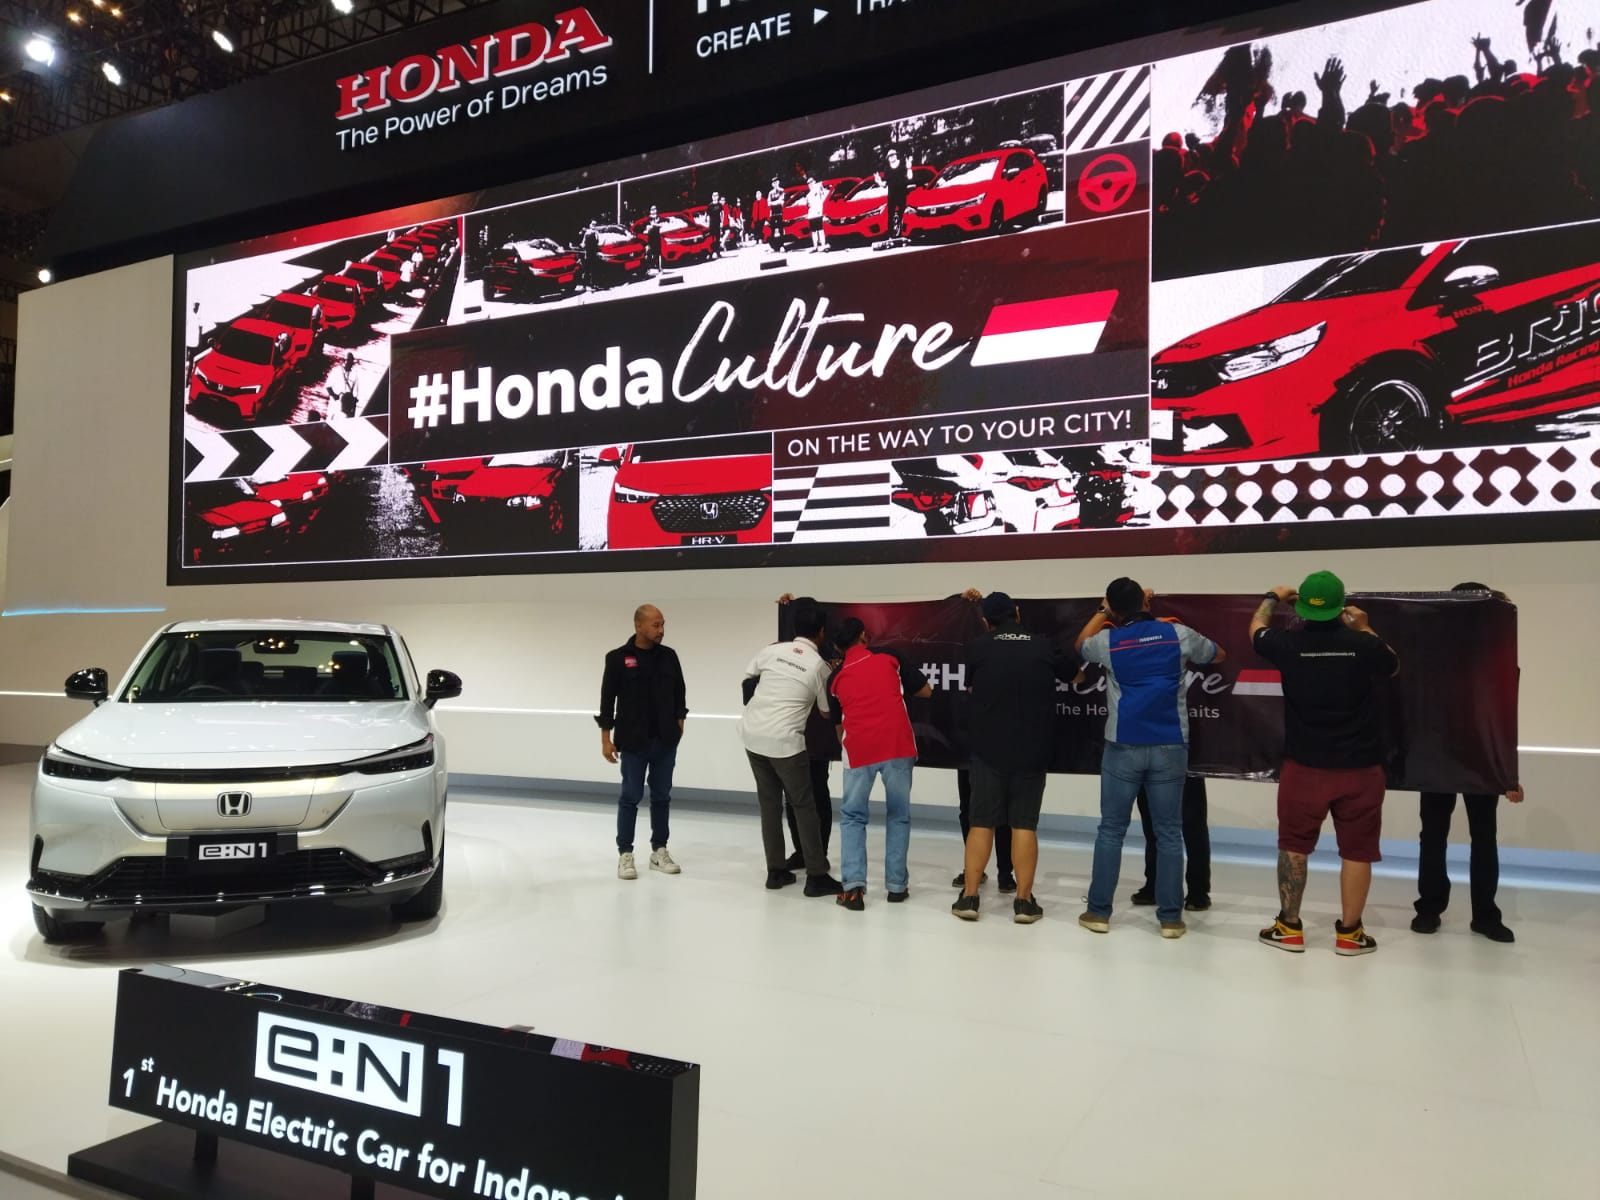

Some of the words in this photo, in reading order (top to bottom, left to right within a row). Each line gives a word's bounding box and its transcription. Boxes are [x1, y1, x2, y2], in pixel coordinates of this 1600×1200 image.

[336, 6, 613, 120] HONDA
[696, 12, 791, 58] CREATE
[336, 126, 378, 151] The
[385, 104, 461, 139] Power
[467, 90, 495, 118] of
[502, 65, 607, 110] Dreams
[1464, 292, 1600, 382] BRI
[1507, 361, 1554, 388] Honda
[1556, 340, 1600, 367] Racing
[788, 438, 820, 458] ON
[827, 434, 871, 454] THE
[878, 427, 935, 450] WAY
[941, 424, 974, 445] TO
[981, 417, 1055, 441] YOUR
[1064, 409, 1132, 434] CITY!
[1056, 703, 1081, 716] The
[1086, 703, 1108, 716] He
[1188, 704, 1220, 719] aits
[156, 1076, 238, 1126] Honda
[245, 1098, 349, 1157] Electric
[356, 1129, 409, 1172] Car
[417, 1142, 465, 1187] for
